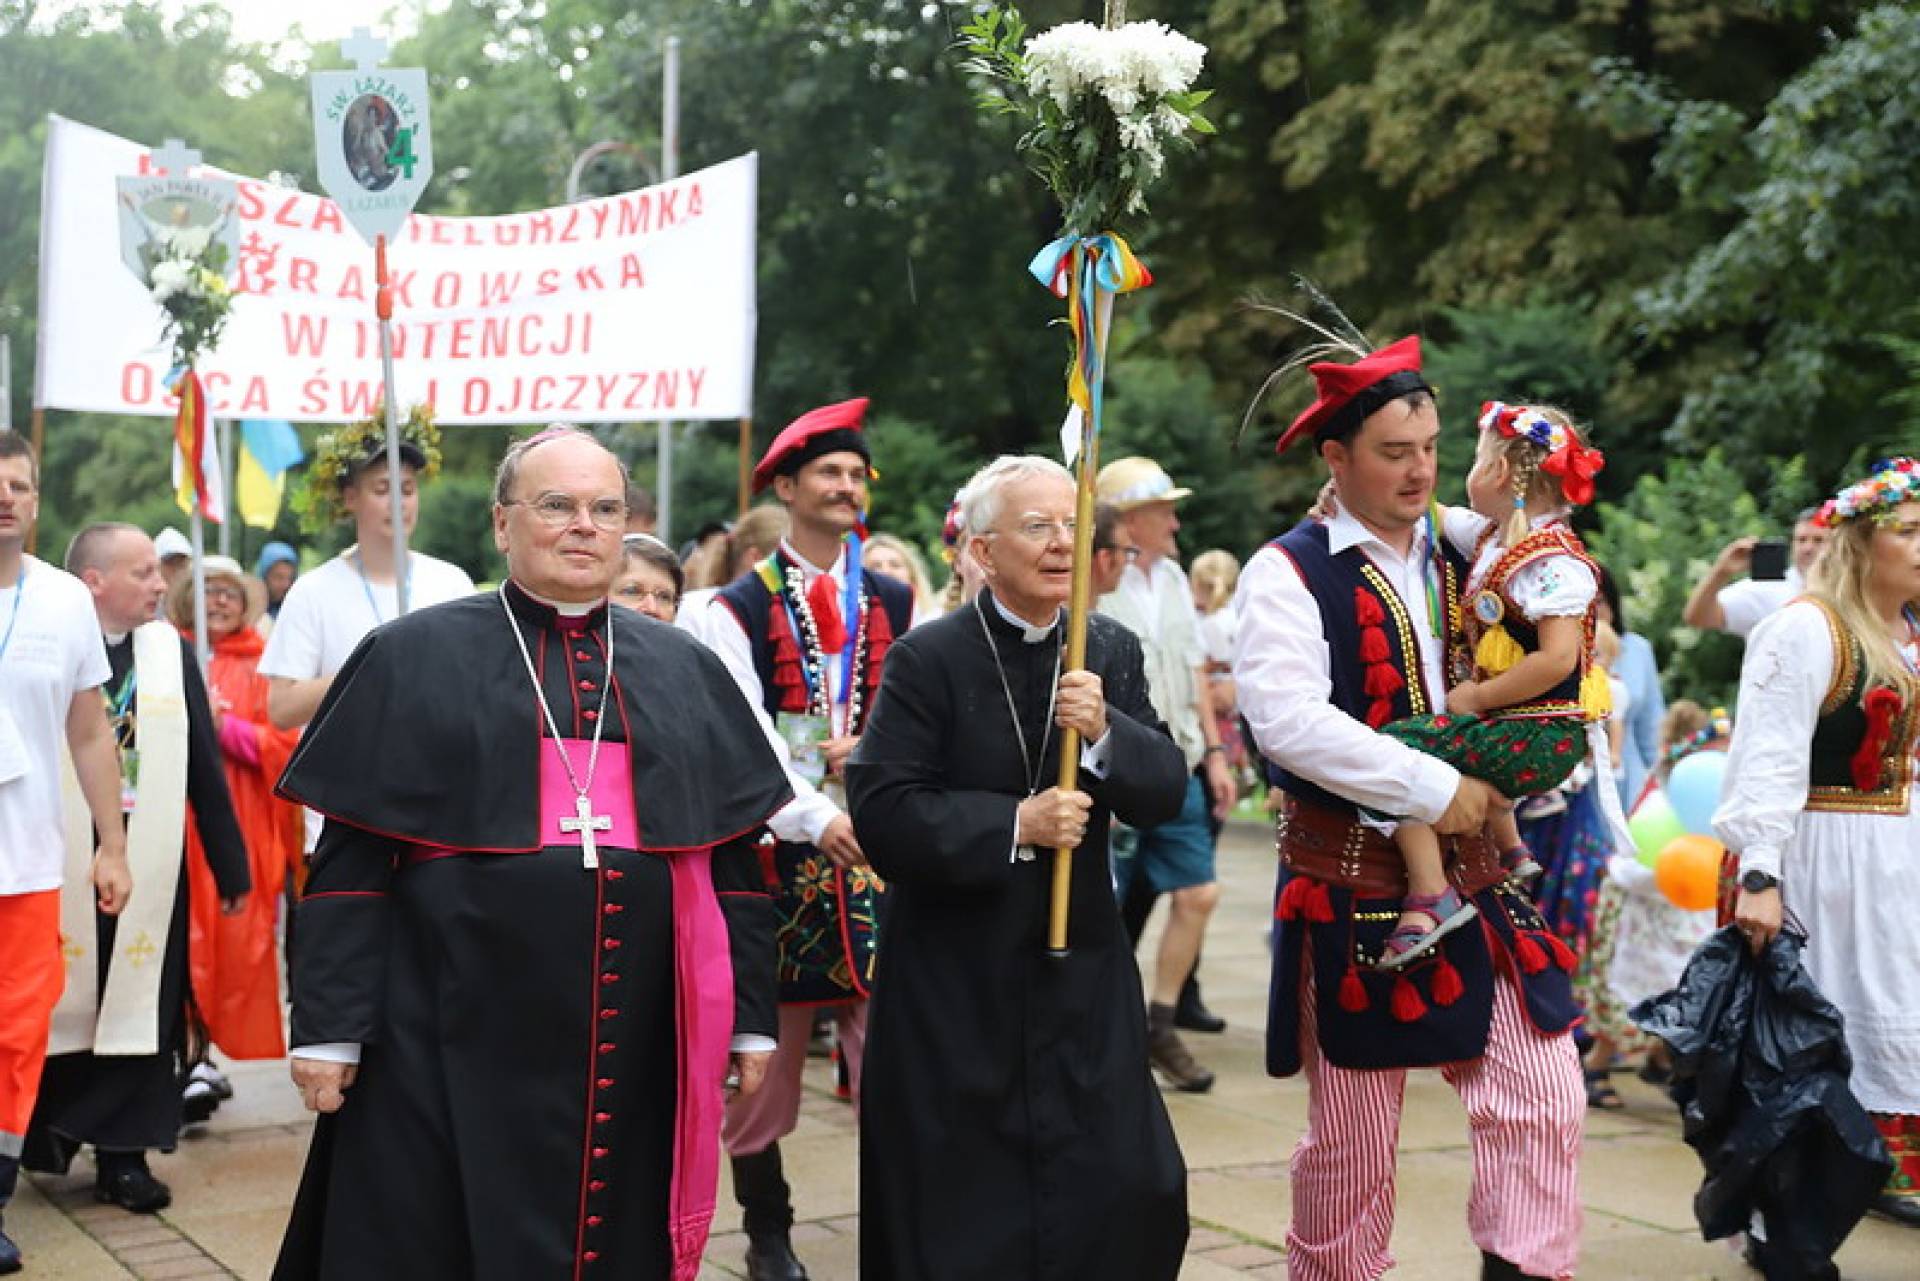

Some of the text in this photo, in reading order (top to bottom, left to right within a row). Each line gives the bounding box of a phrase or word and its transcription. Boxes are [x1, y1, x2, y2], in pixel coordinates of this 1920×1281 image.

[385, 128, 418, 179] 4
[282, 312, 593, 361] W INTENCJI
[462, 367, 708, 417] OJCZYZNY
